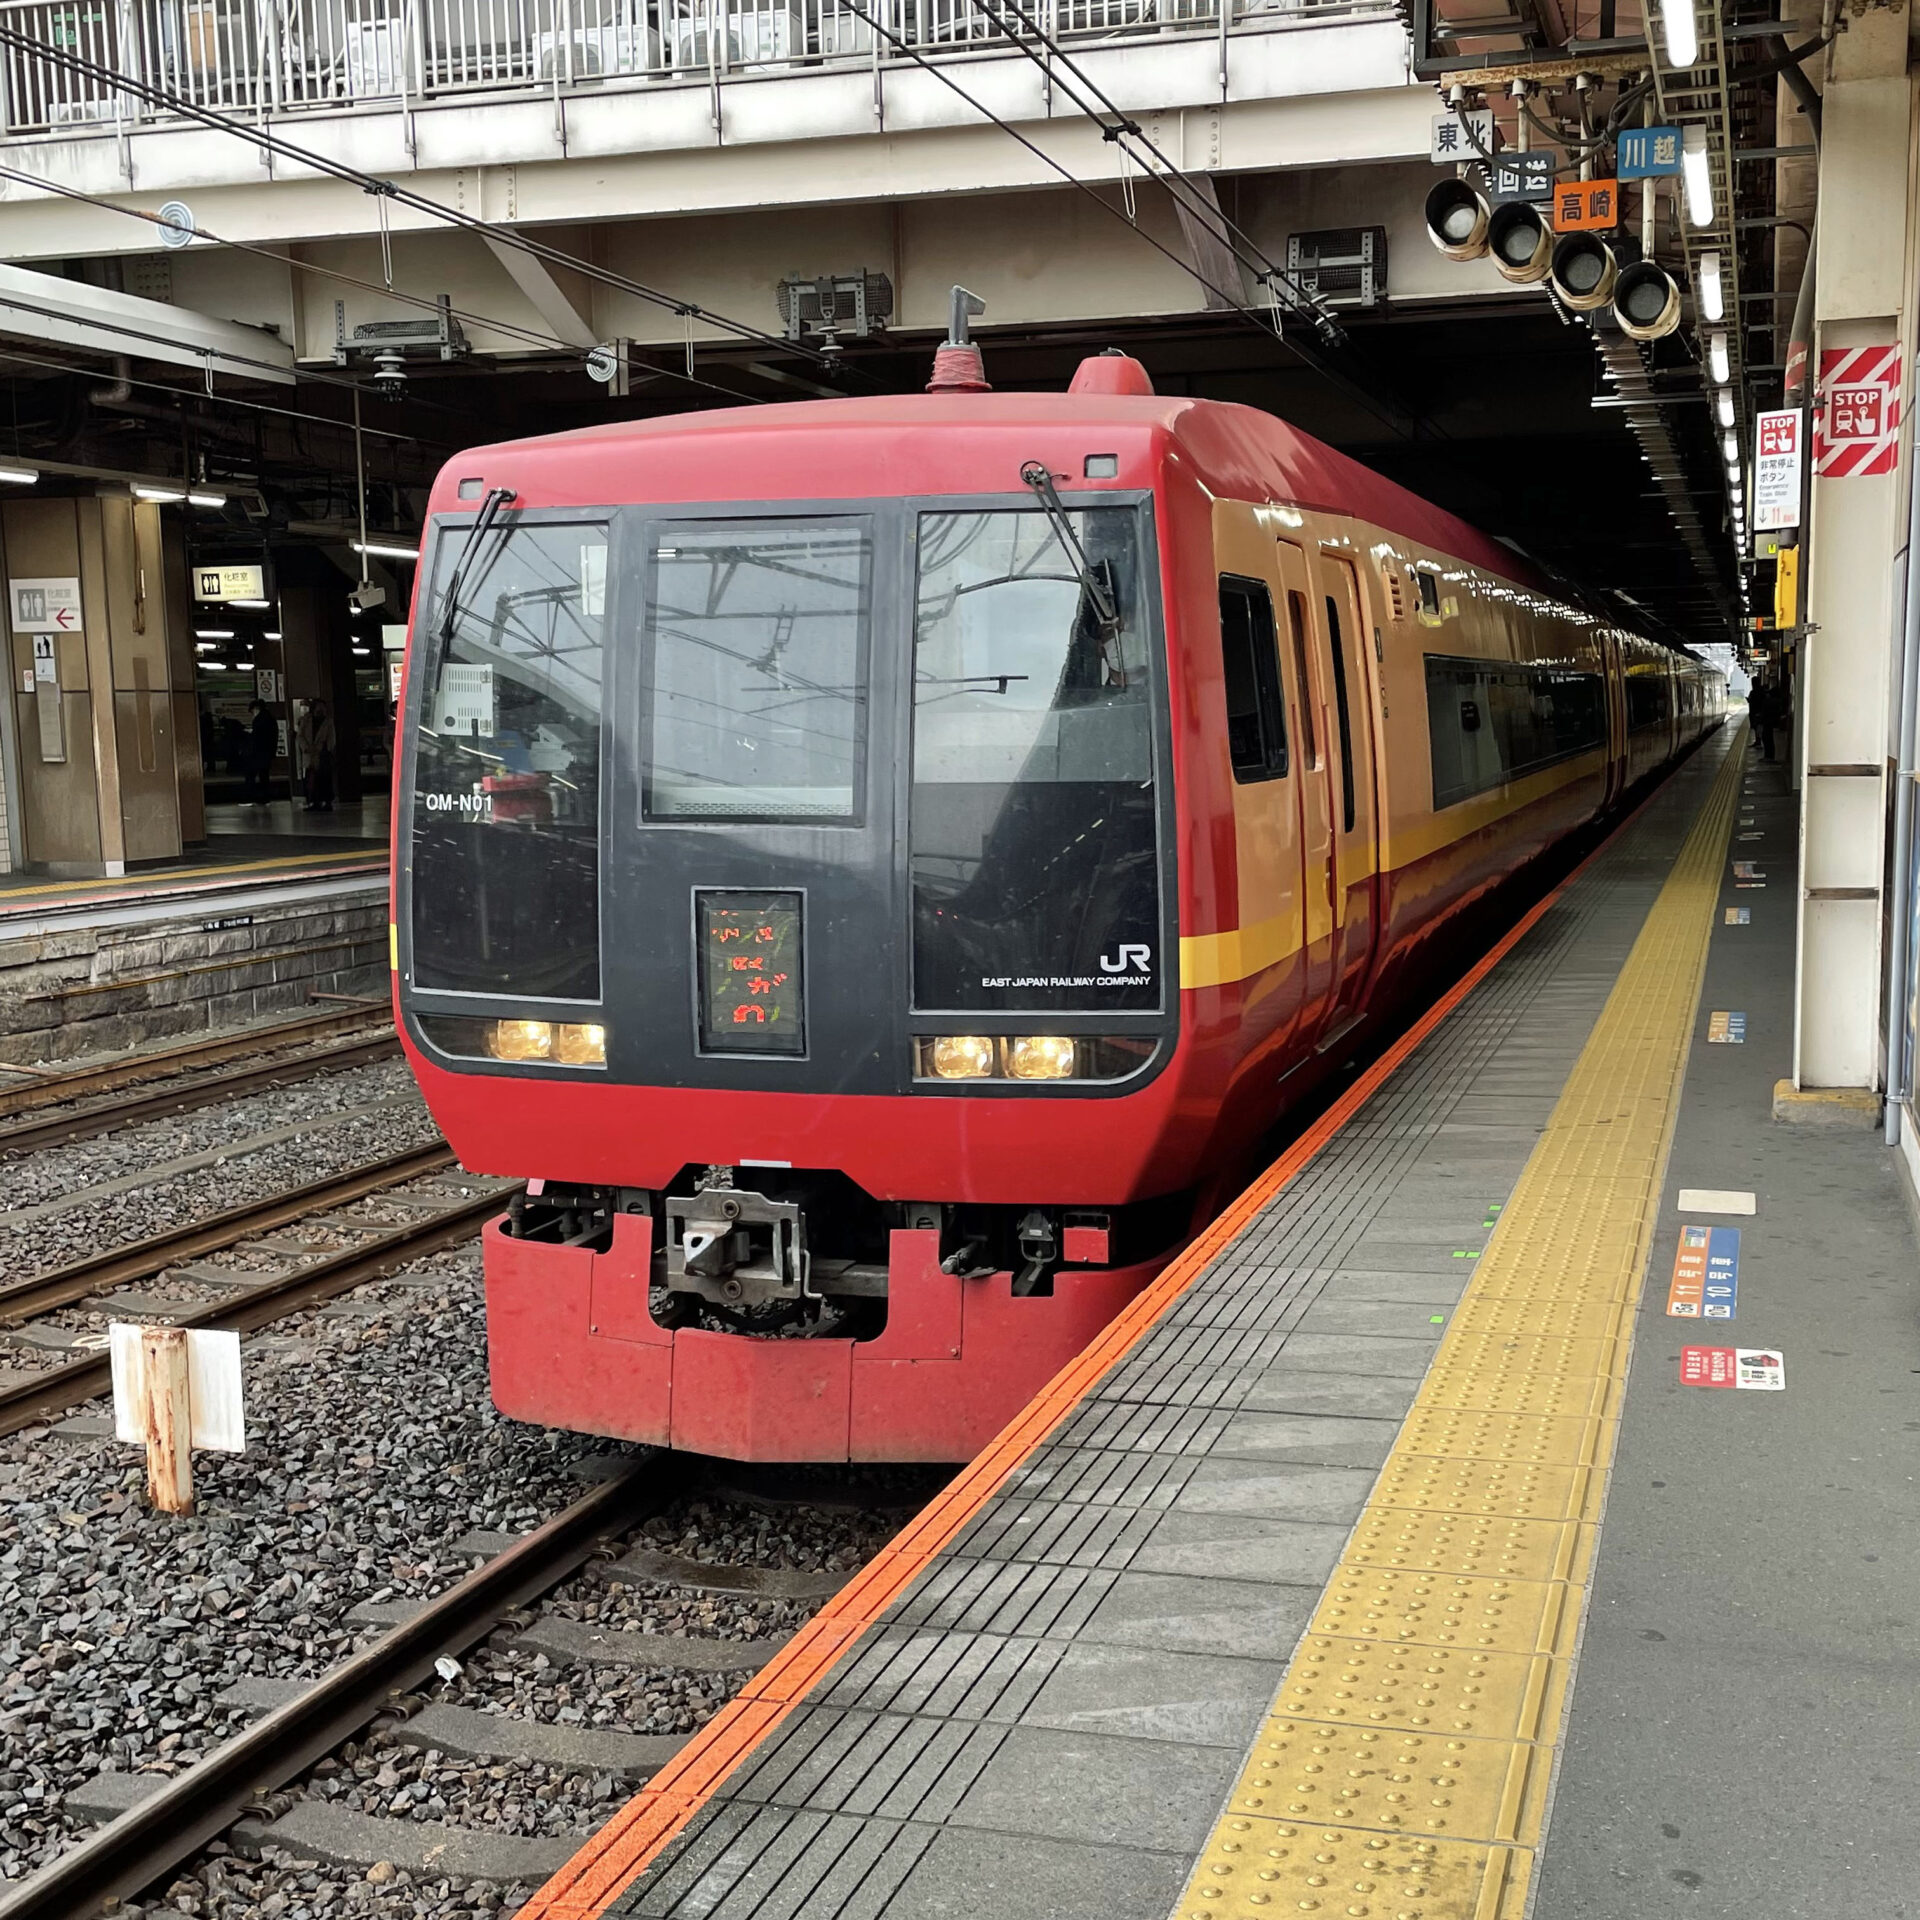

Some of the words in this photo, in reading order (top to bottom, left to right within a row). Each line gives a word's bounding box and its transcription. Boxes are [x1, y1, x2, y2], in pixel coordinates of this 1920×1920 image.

[1437, 119, 1487, 152] 東北
[1623, 135, 1676, 169] 川越
[1497, 159, 1548, 194] 回送
[1560, 190, 1611, 223] 高崎
[1835, 391, 1879, 406] STOP
[1763, 417, 1795, 430] STOP
[1760, 457, 1795, 470] 非常停止
[1760, 472, 1786, 483] ボタン
[426, 793, 492, 812] OM-N01
[1100, 944, 1151, 973] JR
[982, 977, 1012, 987] EAST
[1012, 977, 1048, 987] JAPAN
[1050, 977, 1095, 987] RAILWAY
[1096, 976, 1151, 986] COMPANY
